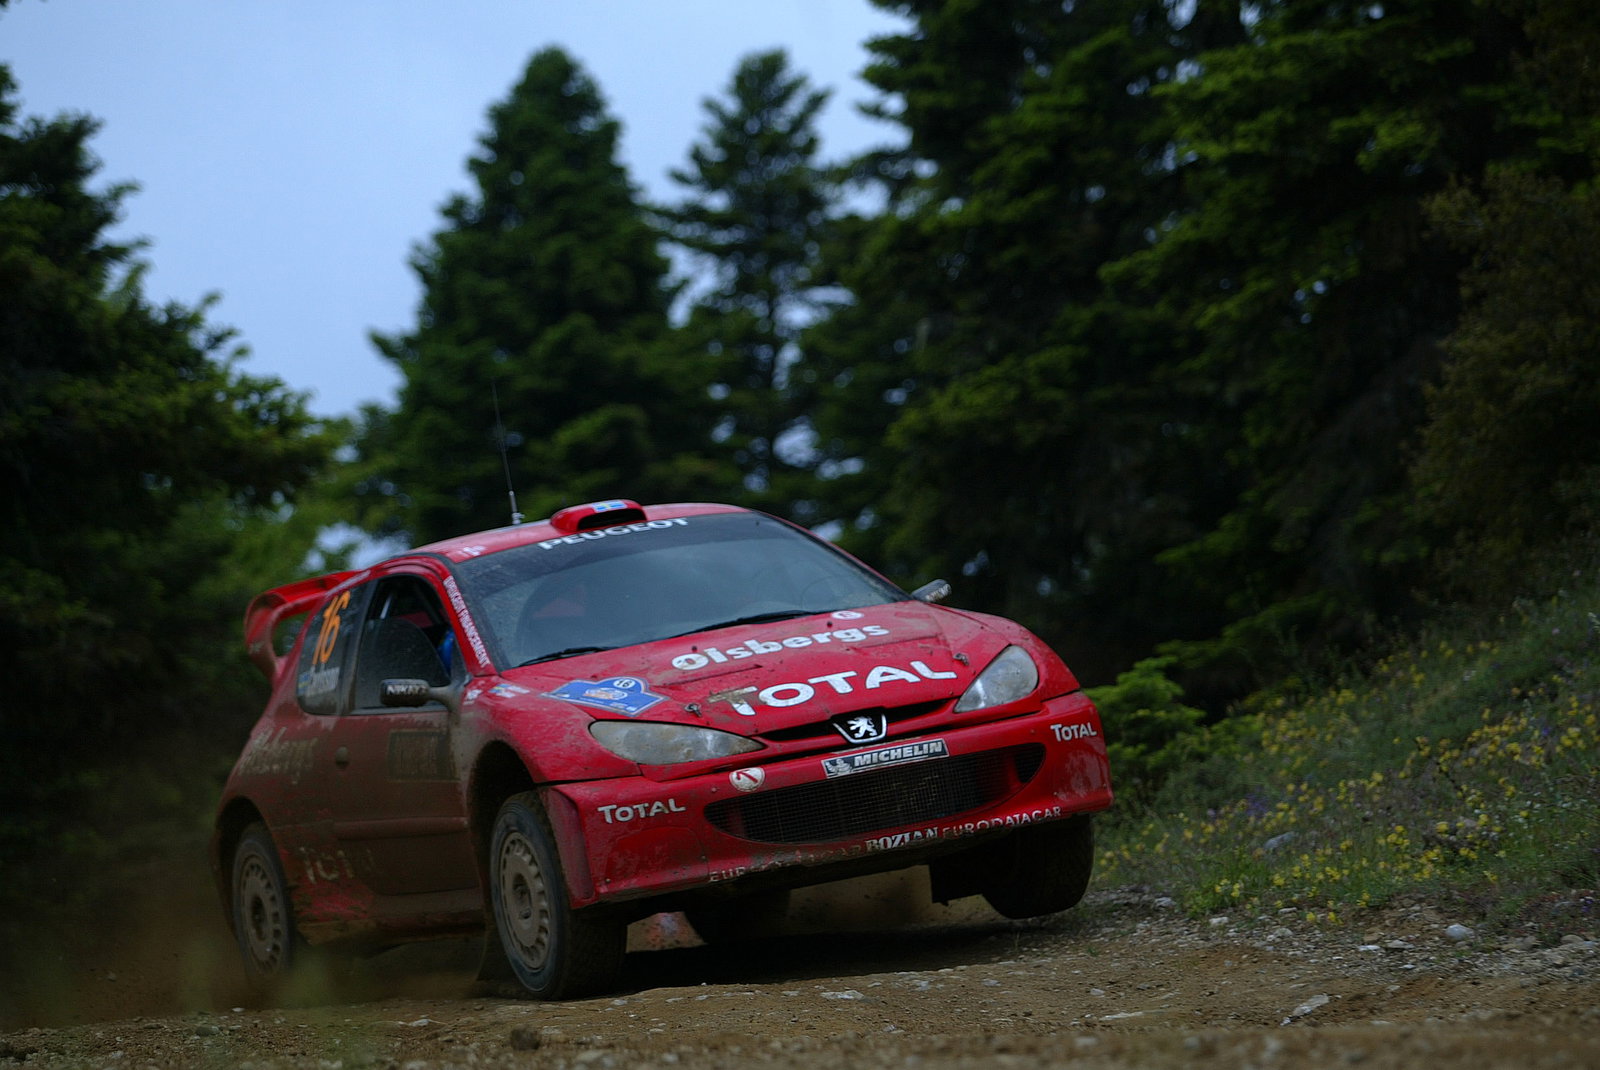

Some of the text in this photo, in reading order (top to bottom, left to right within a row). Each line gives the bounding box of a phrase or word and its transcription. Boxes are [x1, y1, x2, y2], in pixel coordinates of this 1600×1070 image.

[537, 517, 689, 551] PEUGEOT
[312, 590, 351, 665] 16
[671, 625, 890, 671] Olsbergs
[616, 679, 632, 688] 16
[709, 661, 957, 716] TOTAL
[1050, 722, 1098, 742] TOTAL
[854, 741, 942, 767] MICHELIN
[597, 798, 686, 824] TOTAL
[942, 806, 1063, 841] EURODATACAR
